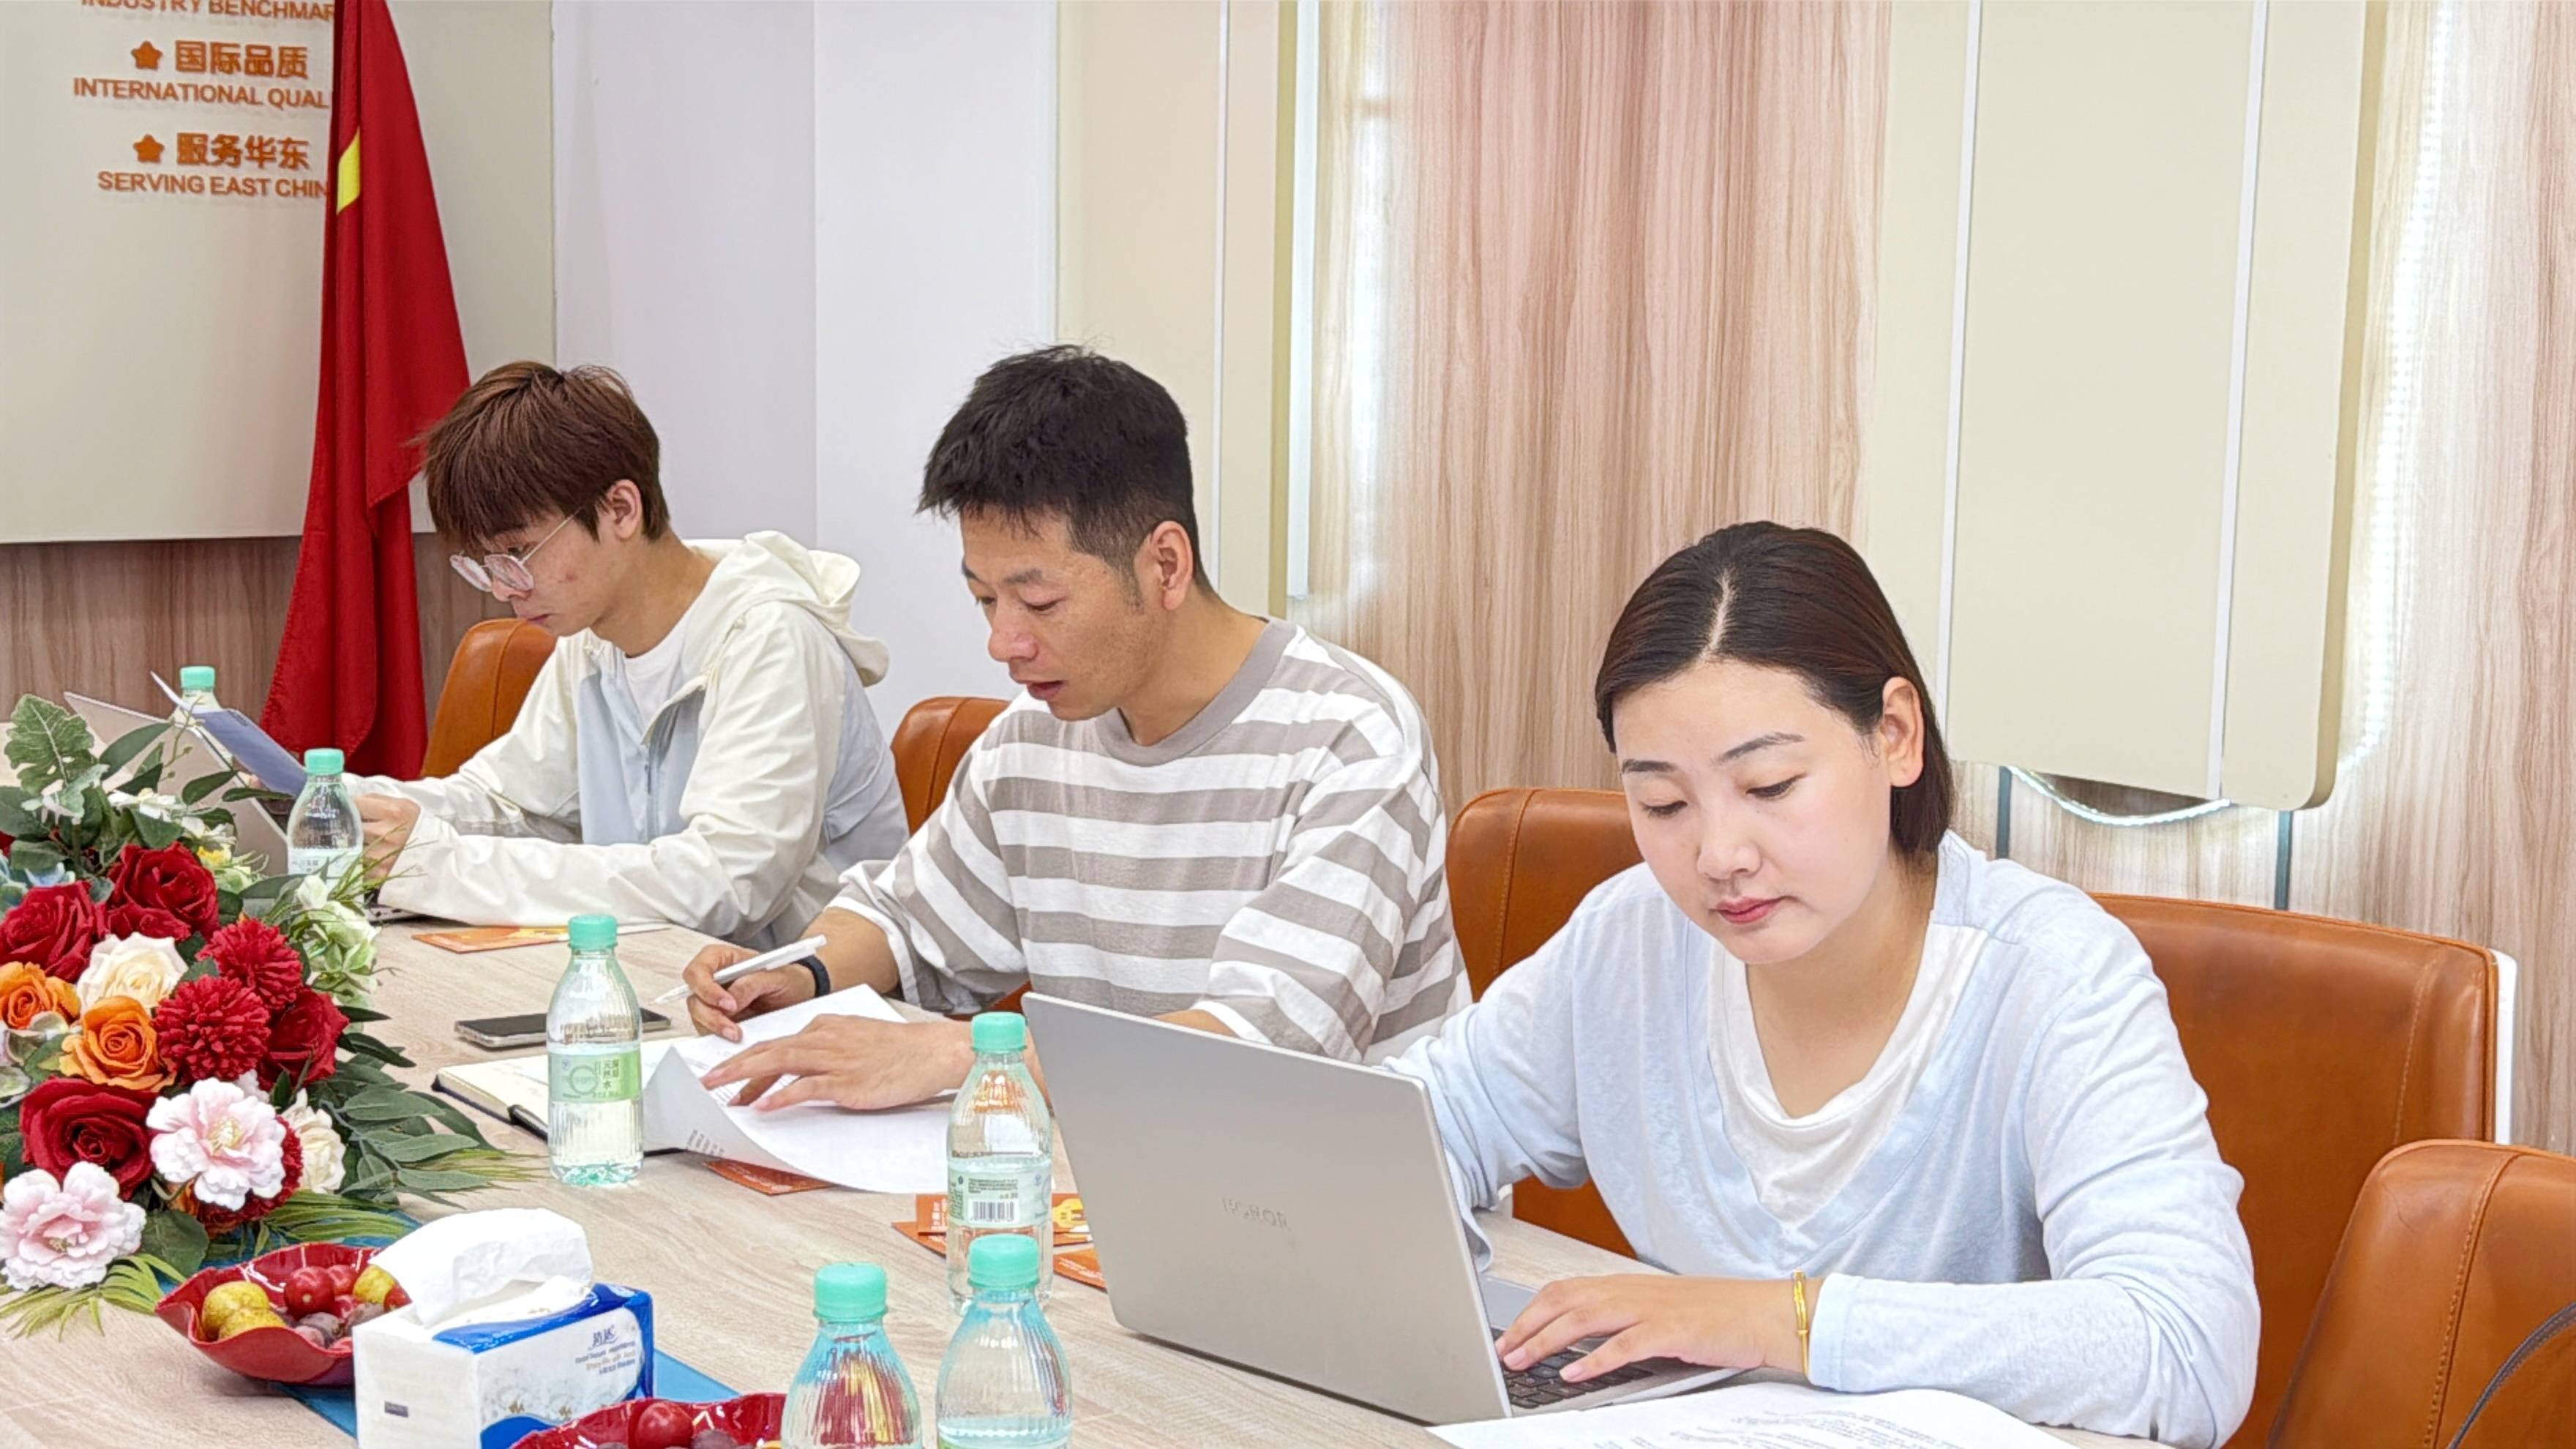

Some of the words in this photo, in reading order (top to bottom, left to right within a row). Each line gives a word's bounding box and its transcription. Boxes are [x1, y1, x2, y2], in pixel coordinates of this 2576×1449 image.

[175, 40, 308, 80] 国际品质
[73, 78, 263, 106] INTERNATIONAL
[267, 88, 330, 110] QUAL
[176, 132, 310, 171] 服务华东
[97, 171, 206, 195] SERVING
[209, 176, 271, 197] EAST
